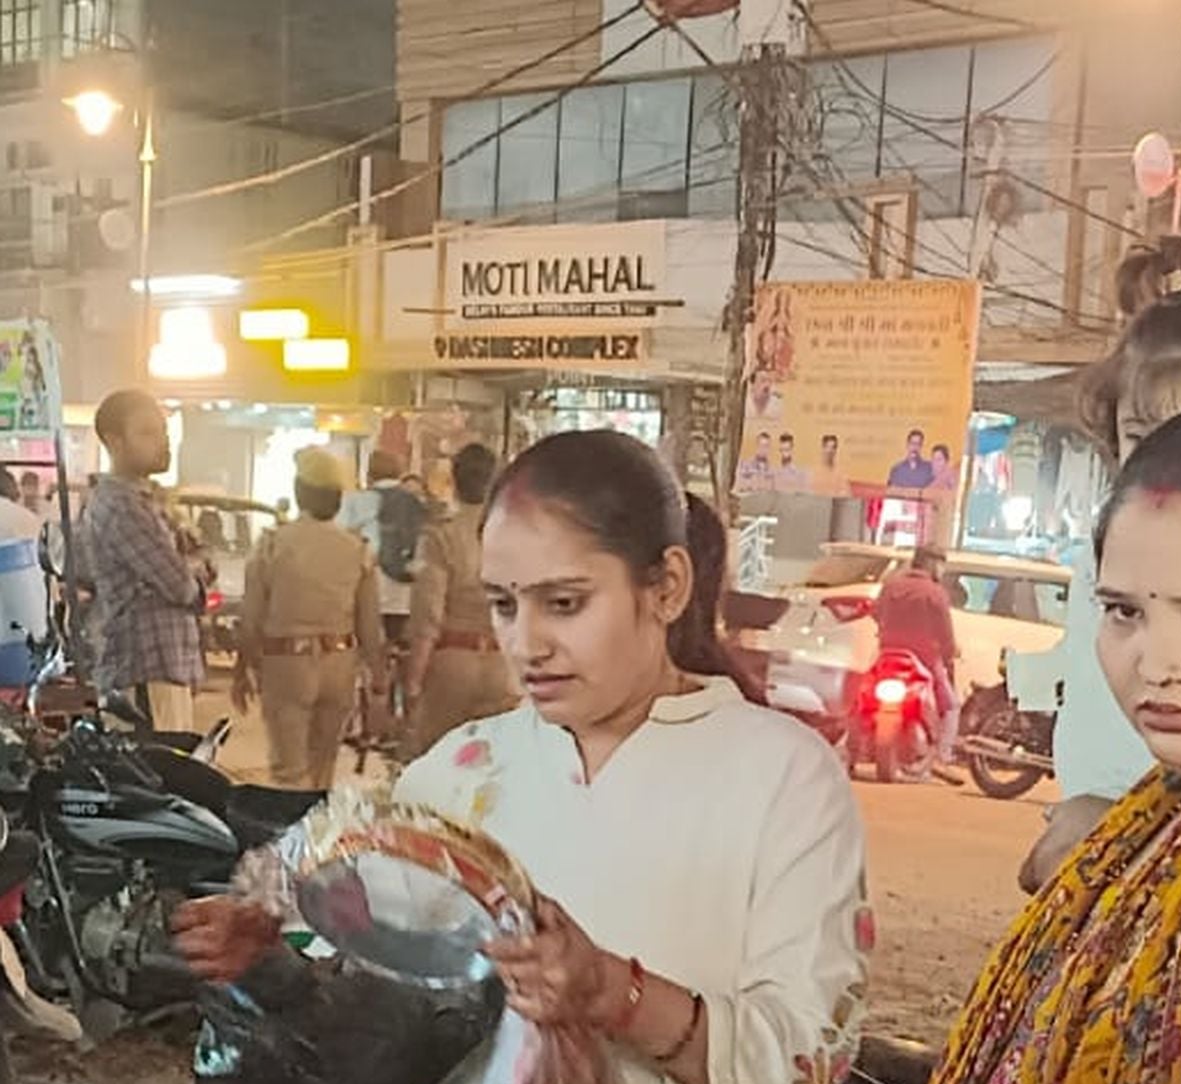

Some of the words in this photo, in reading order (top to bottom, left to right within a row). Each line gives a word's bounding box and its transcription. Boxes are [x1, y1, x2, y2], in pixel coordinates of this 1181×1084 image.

[461, 262, 529, 297] MOTI
[537, 255, 655, 295] MAHAL
[547, 335, 639, 360] COPLEX
